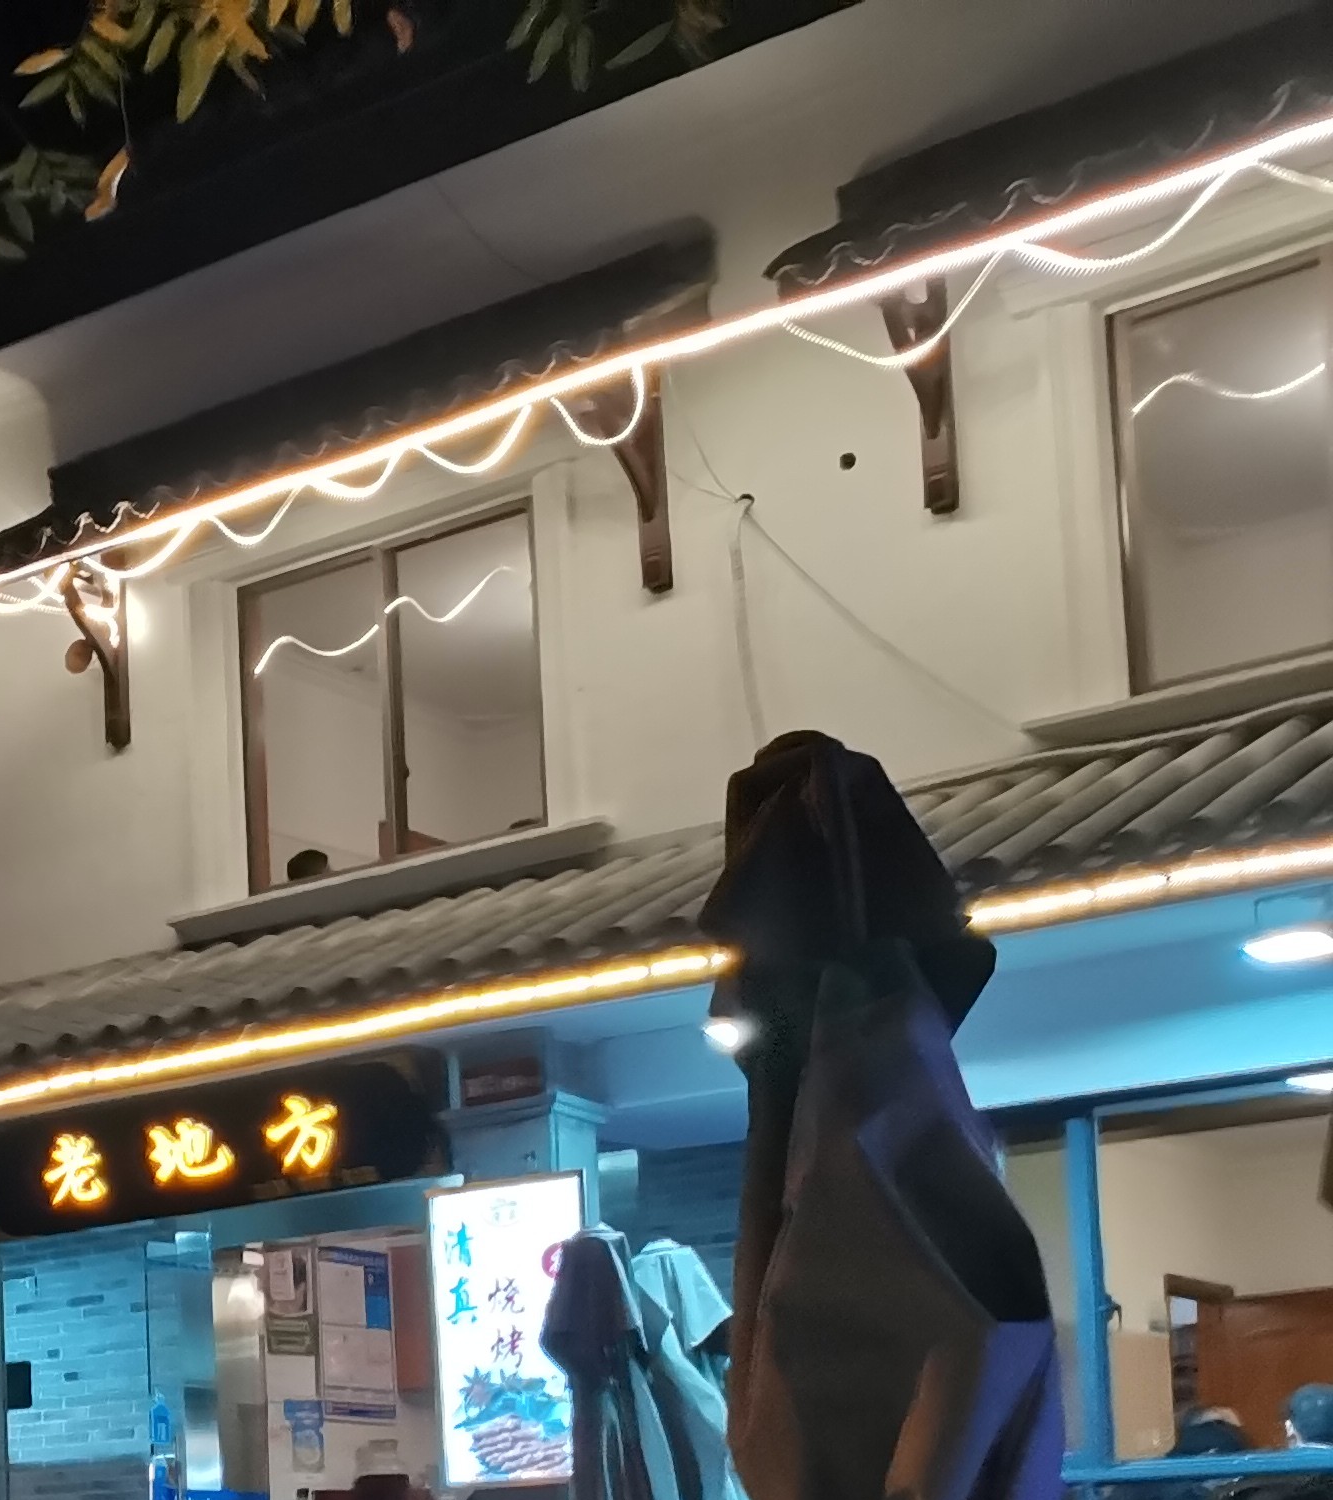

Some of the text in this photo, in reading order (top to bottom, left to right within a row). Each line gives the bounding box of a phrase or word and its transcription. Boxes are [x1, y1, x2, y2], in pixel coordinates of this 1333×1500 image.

[42, 1093, 339, 1207] 老地方
[444, 1221, 478, 1325] 清真
[487, 1276, 526, 1369] 烧烤
